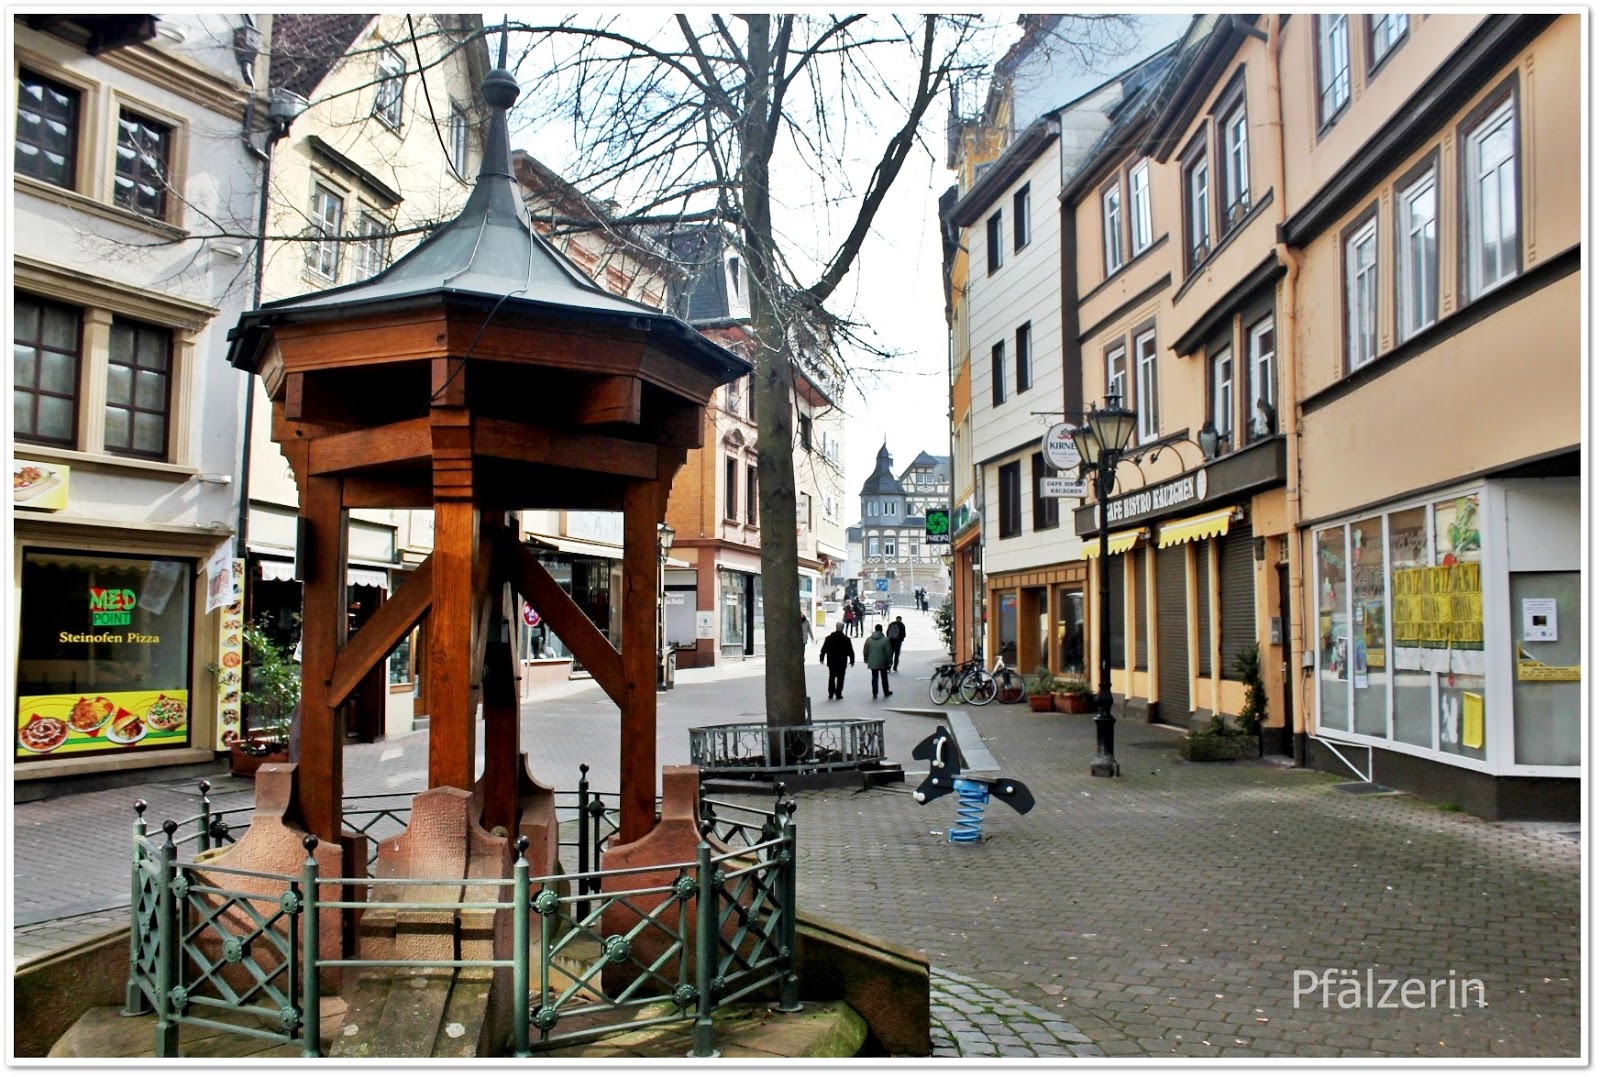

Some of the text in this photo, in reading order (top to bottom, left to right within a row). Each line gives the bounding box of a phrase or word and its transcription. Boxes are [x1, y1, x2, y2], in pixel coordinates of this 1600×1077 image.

[1049, 442, 1079, 450] KIRNE
[1123, 491, 1152, 519] BISTRO
[89, 588, 137, 611] MED
[94, 612, 131, 624] POINT
[59, 631, 160, 643] Steinofen Pizza
